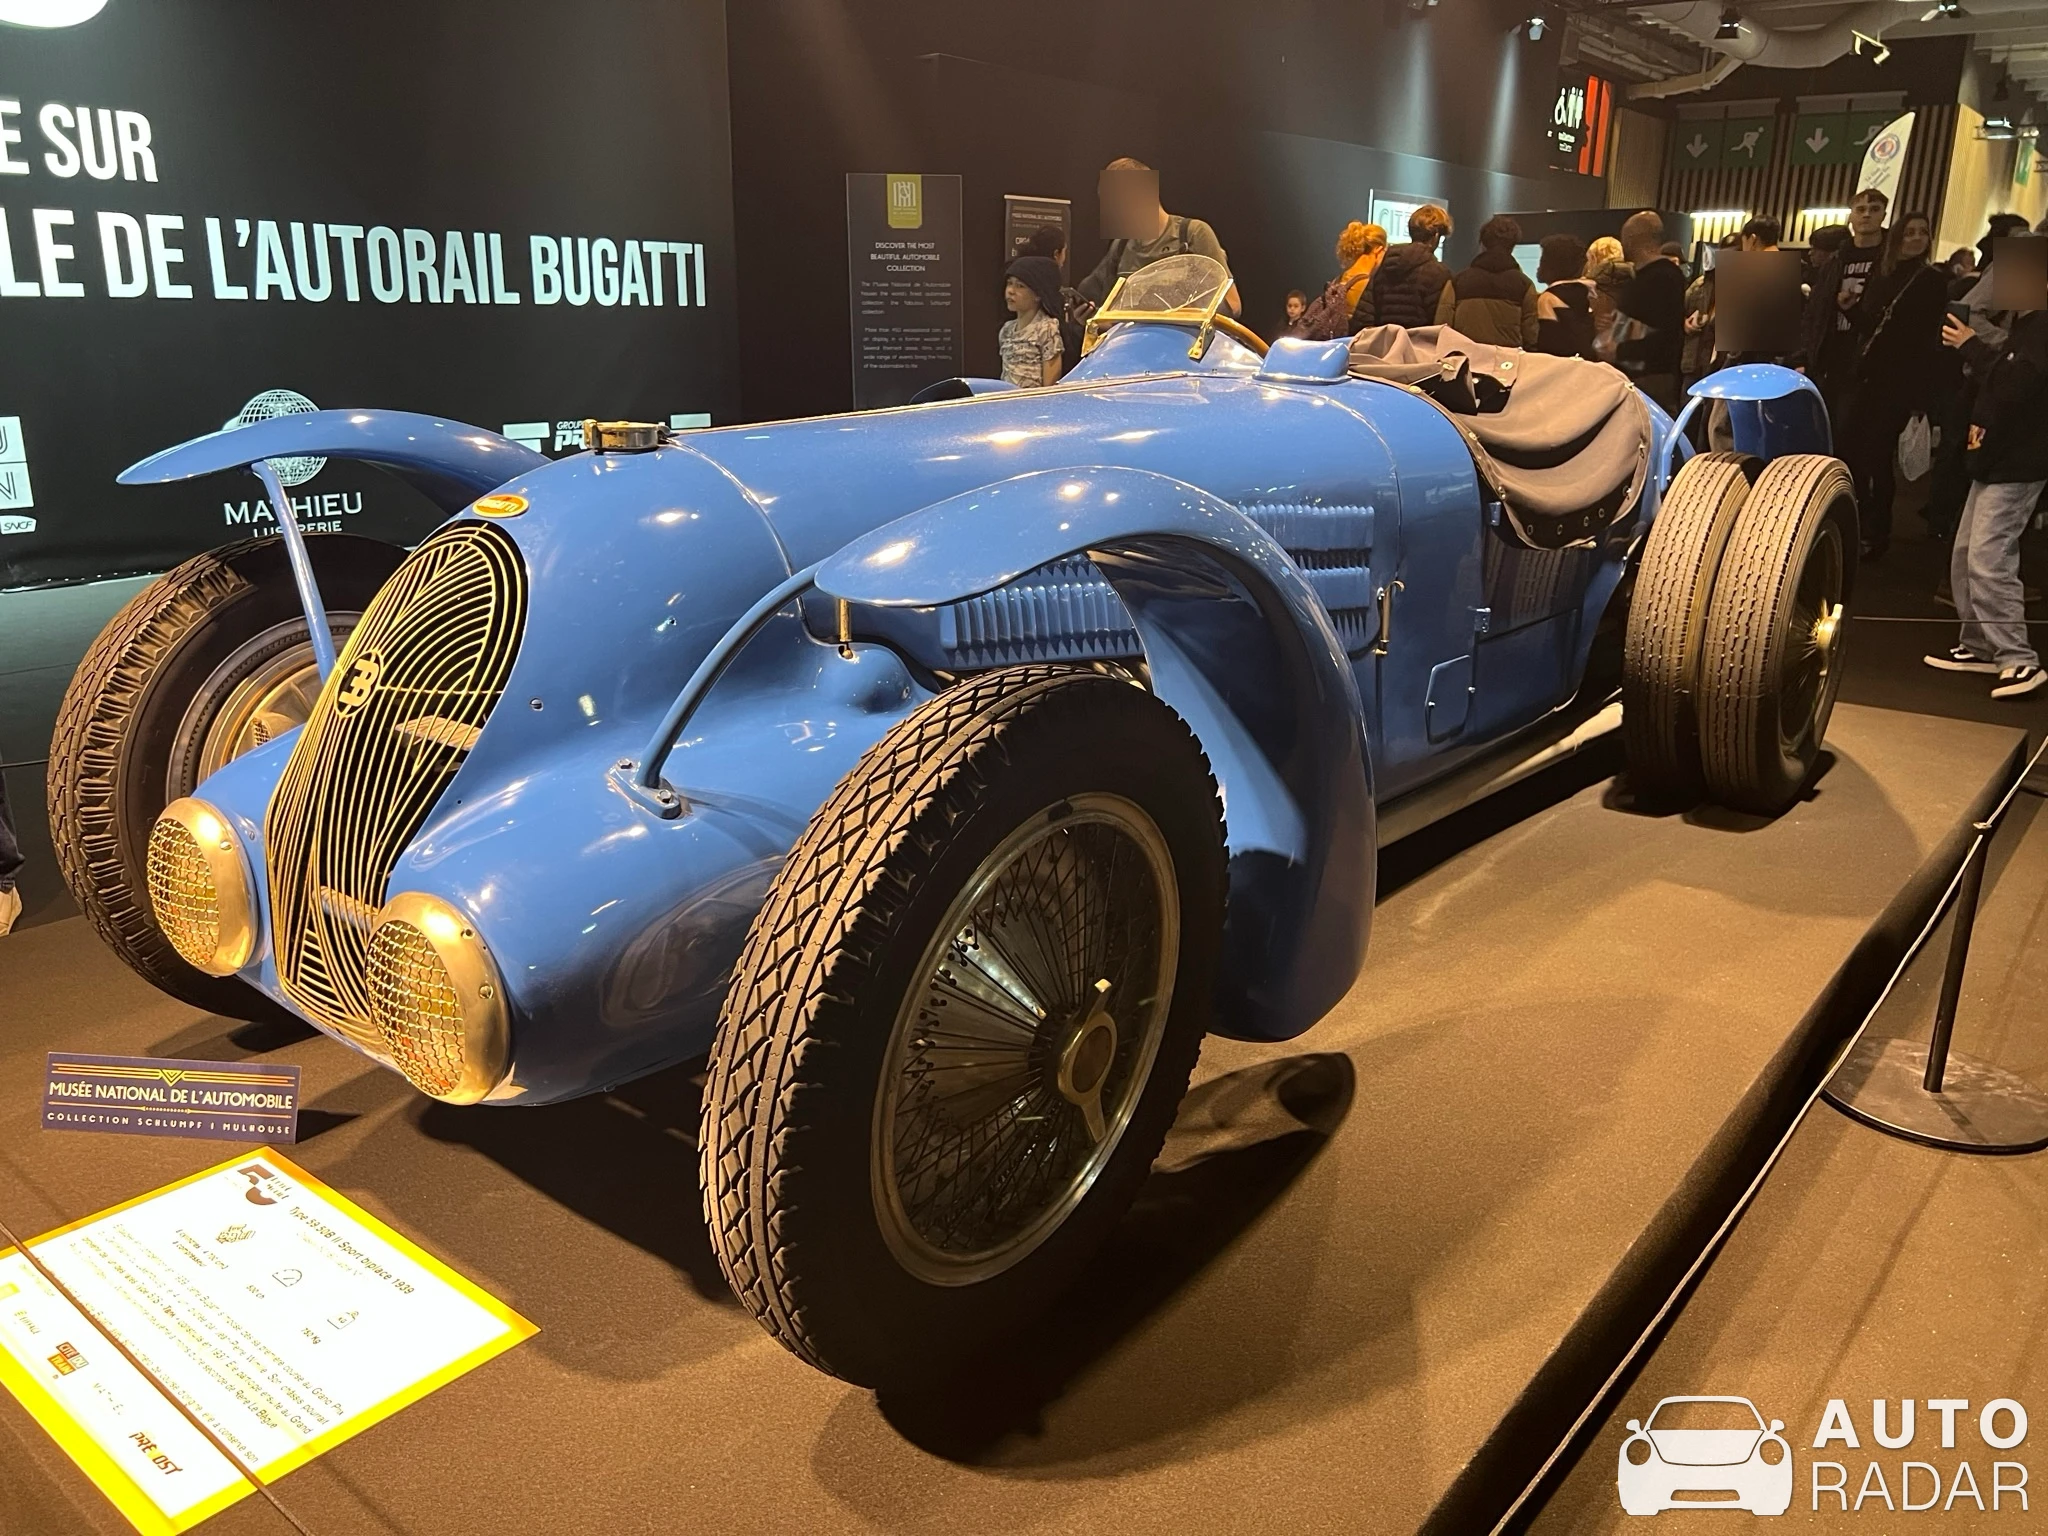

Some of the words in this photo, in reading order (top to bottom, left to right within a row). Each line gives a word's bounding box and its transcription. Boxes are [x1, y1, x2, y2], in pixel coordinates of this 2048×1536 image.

[39, 103, 158, 182] SUR
[0, 207, 85, 297] LE
[97, 211, 193, 298] DE
[205, 217, 520, 304] L'AUTORAIL
[530, 235, 706, 307] BUGATTI
[3, 520, 33, 532] SNCF
[223, 491, 363, 526] MAHIEU
[49, 1080, 92, 1099] MUSÉE
[95, 1084, 167, 1103] NATIONAL
[170, 1089, 187, 1103] DE
[191, 1089, 293, 1110] L'AUTOMOBILE
[47, 1112, 129, 1125] COLLECTION
[137, 1117, 203, 1130] SCHLUMPF
[223, 1122, 291, 1135] MULHOUSE
[289, 1206, 309, 1221] Type
[337, 1241, 364, 1260] Sport
[360, 1257, 392, 1280] biplace
[391, 1278, 415, 1295] 1939
